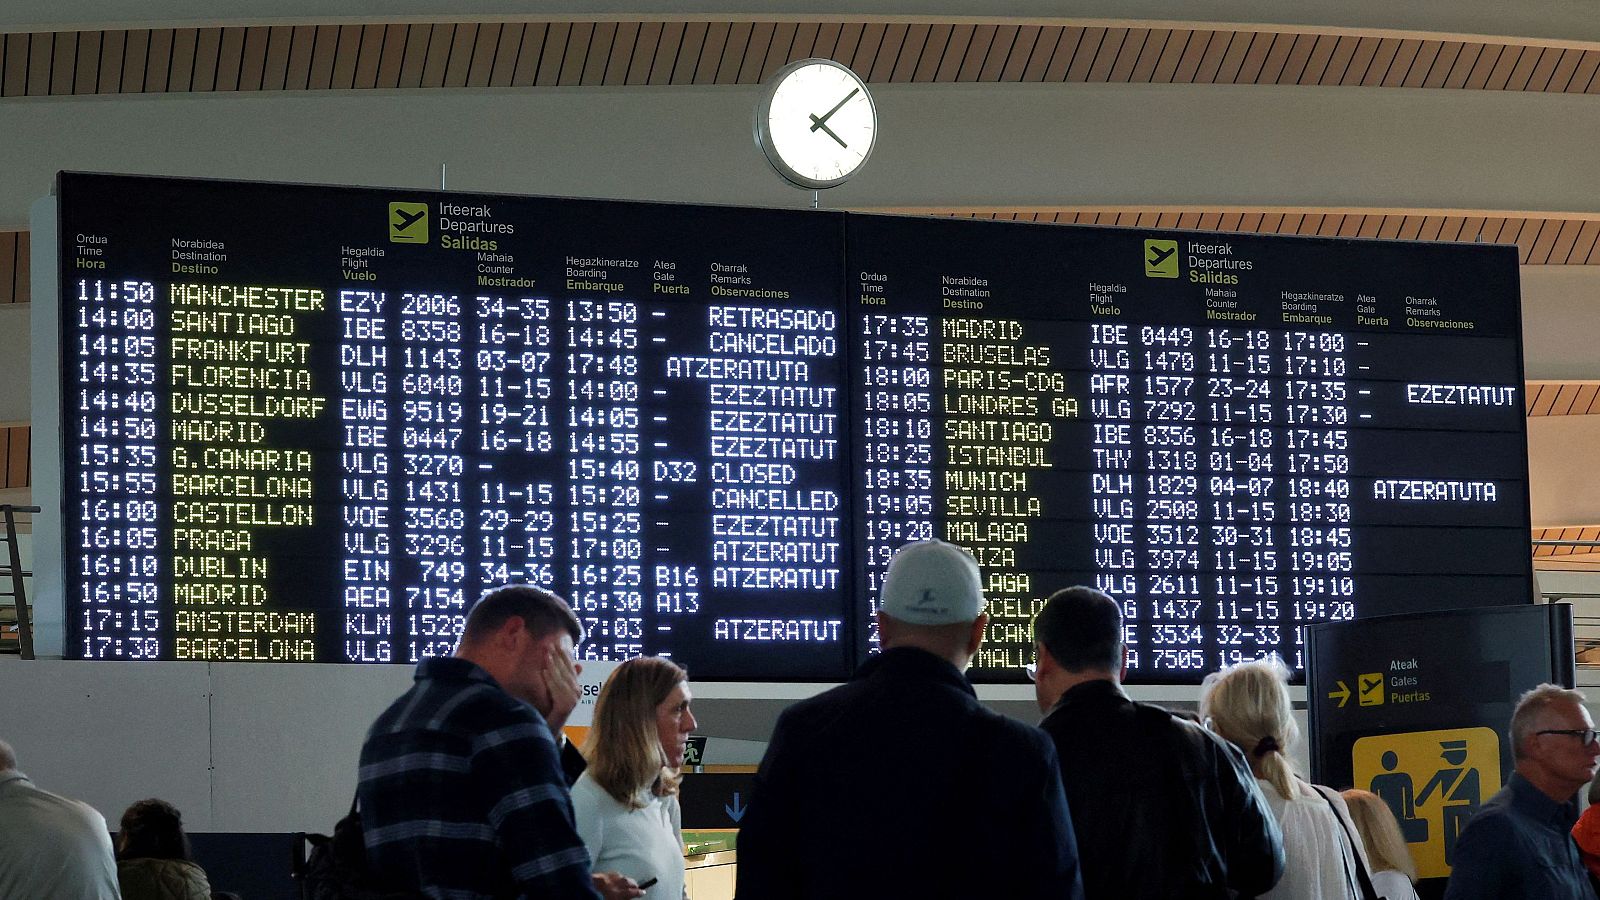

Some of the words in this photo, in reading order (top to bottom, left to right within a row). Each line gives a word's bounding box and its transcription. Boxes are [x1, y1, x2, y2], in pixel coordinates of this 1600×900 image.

[439, 203, 492, 217] Irteerak
[440, 218, 514, 235] Departures
[76, 234, 108, 244] Ordua
[171, 238, 225, 249] Norabidea
[440, 235, 498, 250] Salidas
[76, 246, 103, 256] Time
[341, 246, 385, 257] Hegaldia
[1188, 242, 1233, 254] Irteerak
[172, 250, 227, 261] Destination
[477, 252, 514, 263] Mahaia
[76, 258, 106, 269] Hora
[172, 263, 219, 274] Destino
[341, 258, 368, 269] Flight
[565, 256, 640, 269] Hegazkineratze
[653, 260, 676, 270] Atea
[710, 263, 748, 273] Oharrak
[1188, 256, 1253, 272] Departures
[477, 264, 515, 274] Counter
[566, 268, 607, 280] Boarding
[342, 270, 377, 281] Vuelo
[477, 276, 536, 287] Mostrador
[653, 272, 675, 281] Gate
[710, 274, 752, 285] Remarks
[860, 272, 888, 282] Ordua
[942, 276, 988, 287] Norabidea
[1189, 270, 1239, 284] Salidas
[566, 280, 624, 293] Embarque
[653, 283, 690, 294] Puerta
[711, 286, 790, 298] Observaciones
[860, 283, 884, 293] Time
[942, 287, 990, 298] Destination
[1089, 283, 1127, 294] Hegaldia
[1205, 288, 1237, 298] Mahaia
[1281, 291, 1345, 303] Hegazkineratze
[1356, 294, 1376, 303] Atea
[79, 280, 154, 303] 11:50
[171, 284, 324, 310] MANCHESTER
[341, 291, 385, 313] EZY
[402, 294, 460, 316] 2006
[477, 297, 549, 320] 34-35
[568, 301, 636, 323] 13:50
[709, 306, 835, 331] RETRASADO
[860, 295, 887, 305] Hora
[943, 299, 984, 310] Destino
[1089, 294, 1113, 305] Flight
[1206, 299, 1238, 309] Counter
[1405, 296, 1438, 306] Oharrak
[1090, 305, 1121, 316] Vuelo
[1281, 302, 1317, 313] Boarding
[1356, 305, 1376, 314] Gate
[1405, 307, 1441, 317] Remarks
[1206, 310, 1257, 321] Mostrador
[1282, 312, 1332, 325] Embarque
[1357, 316, 1389, 326] Puerta
[1406, 318, 1475, 329] Observaciones
[79, 307, 154, 330] 14:00
[172, 311, 293, 335] SANTIAGO
[710, 331, 835, 356] CANCELADO
[863, 315, 928, 336] 17:35
[943, 319, 1022, 340] MADRID
[1092, 324, 1128, 344] IBE
[1142, 326, 1192, 346] 0449
[1209, 329, 1269, 349] 16-18
[1285, 332, 1344, 352] 17:00
[80, 334, 155, 357] 14:05
[172, 338, 310, 363] FRANKFURT
[342, 345, 386, 366] DLH
[405, 347, 461, 369] 1143
[477, 350, 550, 373] 03-07
[568, 354, 637, 375] 17:48
[667, 357, 808, 382] ATZERATUTA
[864, 340, 929, 361] 17:45
[944, 344, 1049, 366] BRUSELAS
[80, 361, 155, 384] 14:35
[173, 365, 310, 390] FLORENCIA
[711, 384, 836, 409] EZEZTATUT
[864, 366, 929, 387] 18:00
[944, 369, 1064, 392] PARIS-CDG
[1407, 384, 1515, 405] EZEZTATUT
[80, 389, 155, 412] 14:40
[173, 393, 325, 418] DUSSELDORF
[342, 399, 387, 420] EWG
[403, 401, 462, 423] 9519
[481, 403, 549, 426] 19-21
[569, 406, 638, 428] 14:05
[710, 409, 836, 435] EZEZTATUT
[865, 392, 930, 412] 18:05
[945, 394, 1038, 416] LONDRES
[1052, 398, 1078, 418] GA
[1092, 399, 1130, 418] VLG
[1144, 401, 1195, 420] 7292
[1211, 403, 1272, 422] 11-15
[1287, 405, 1347, 424] 17:30
[865, 418, 930, 438] 18:10
[945, 420, 1051, 442] SANTIAGO
[81, 416, 155, 439] 14:50
[173, 420, 264, 442] MADRID
[710, 435, 837, 461] EZEZTATUT
[866, 443, 931, 464] 18:25
[948, 445, 1052, 466] ISTANBUL
[81, 444, 156, 467] 15:35
[173, 447, 311, 471] G.CANARIA
[654, 461, 696, 482] D32
[711, 461, 797, 487] CLOSED
[866, 469, 931, 489] 18:35
[946, 471, 1026, 491] MUNICH
[1093, 474, 1132, 494] DLH
[1148, 475, 1197, 495] 1829
[1210, 477, 1273, 496] 04-07
[1289, 479, 1349, 498] 18:40
[1374, 480, 1496, 501] ATZERATUTA
[81, 471, 156, 494] 15:55
[173, 474, 311, 498] BARCELONA
[712, 487, 838, 514] CANCELLED
[866, 494, 932, 515] 19:05
[947, 496, 1040, 516] SEVILLA
[82, 499, 156, 522] 16:00
[174, 502, 312, 525] CASTELLON
[344, 506, 388, 527] VOE
[405, 507, 464, 529] 3568
[480, 510, 553, 531] 29-29
[571, 511, 640, 533] 15:25
[712, 513, 839, 540] EZEZTATUT
[867, 520, 932, 540] 19:20
[946, 522, 1027, 542] MALAGA
[82, 526, 156, 549] 16:05
[174, 529, 250, 551] PRAGA
[712, 539, 839, 565] ATZERATUT
[82, 554, 157, 576] 16:10
[174, 556, 266, 578] DUBLIN
[345, 560, 389, 581] EIN
[420, 561, 466, 582] 749
[480, 563, 553, 583] 34-36
[571, 565, 641, 586] 16:25
[655, 566, 698, 587] B16
[712, 565, 839, 589] ATZERATUT
[82, 582, 157, 603] 16:50
[175, 584, 266, 605] MADRID
[656, 592, 699, 612] A13
[1153, 600, 1201, 618] 1437
[1217, 601, 1278, 619] 11-15
[1294, 601, 1354, 620] 19:20
[84, 609, 158, 631] 17:15
[176, 611, 314, 633] AMSTERDAM
[715, 619, 841, 640] ATZERATUT
[83, 638, 159, 659] 17:30
[176, 638, 315, 661] BARCELONA
[345, 641, 391, 662] VLG
[1390, 658, 1418, 670] Ateak
[1390, 675, 1418, 687] Gates
[1391, 691, 1431, 703] Puertas
